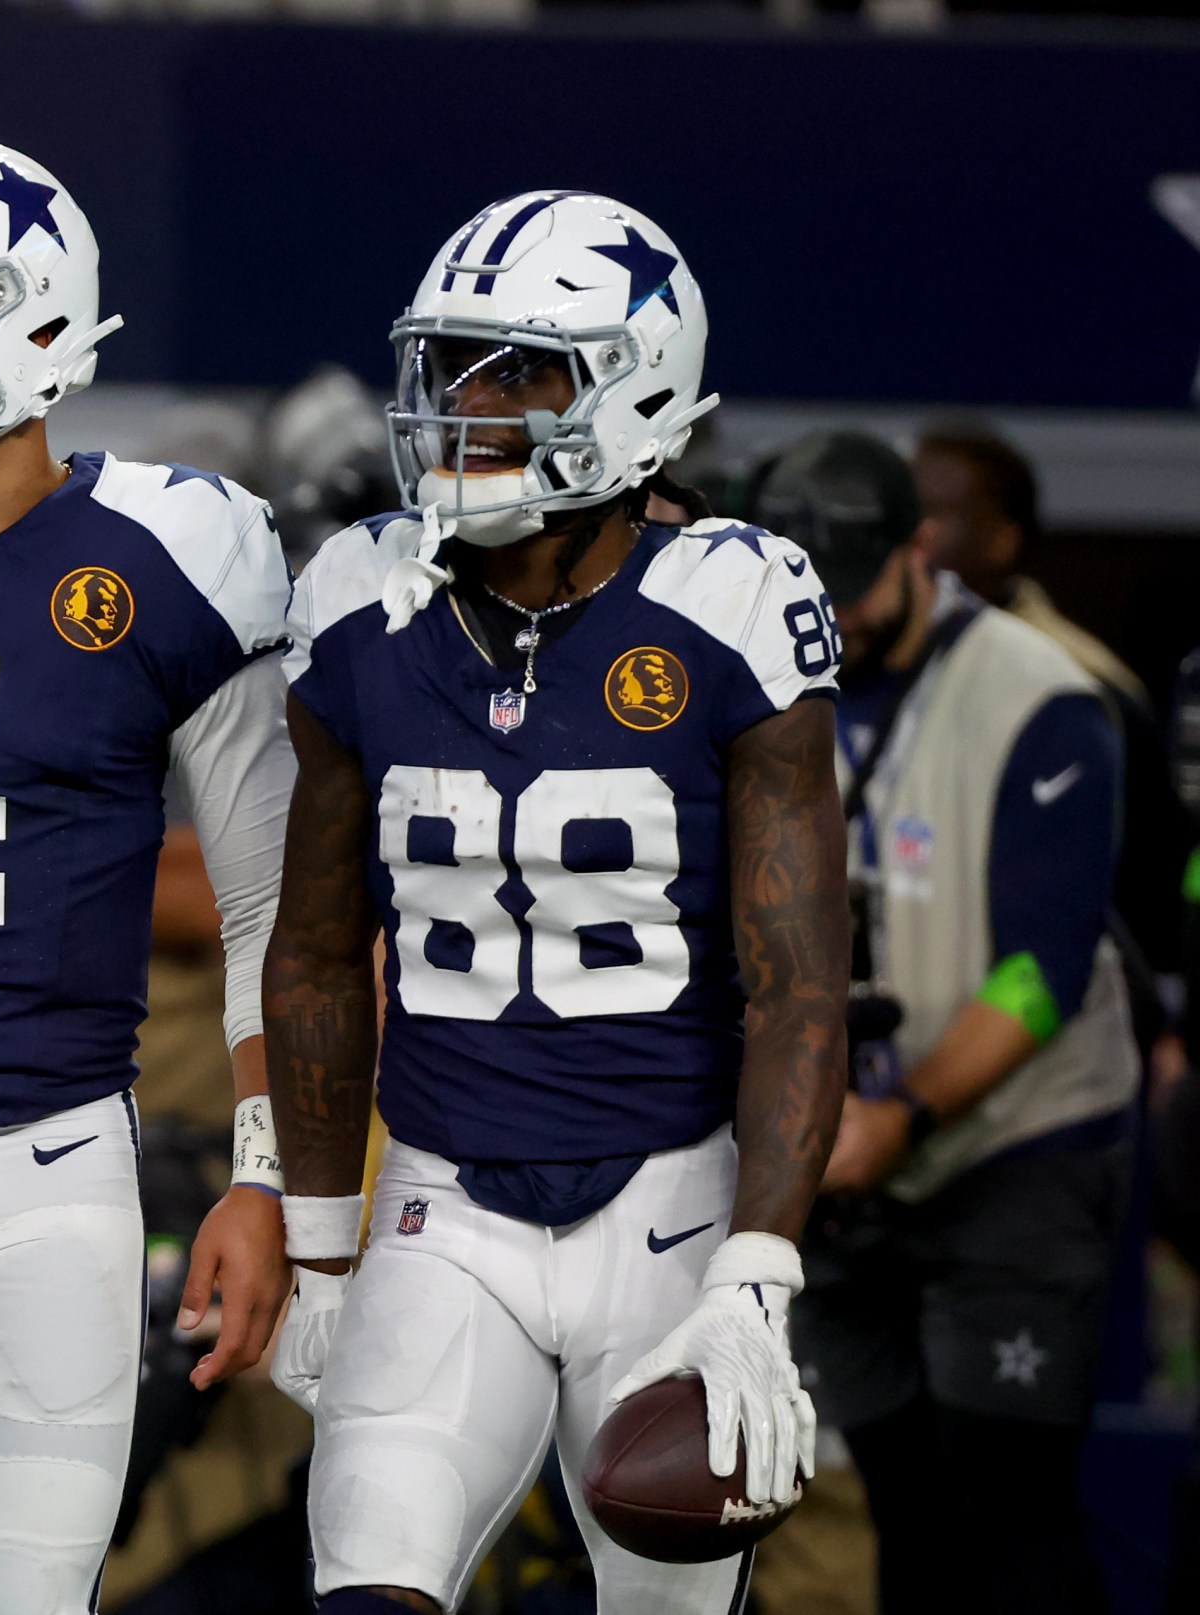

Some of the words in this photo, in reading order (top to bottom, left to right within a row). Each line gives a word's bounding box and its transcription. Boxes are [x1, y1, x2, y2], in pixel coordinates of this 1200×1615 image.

[494, 708, 518, 724] NFL
[378, 765, 690, 1021] 88
[401, 1214, 422, 1230] NFL
